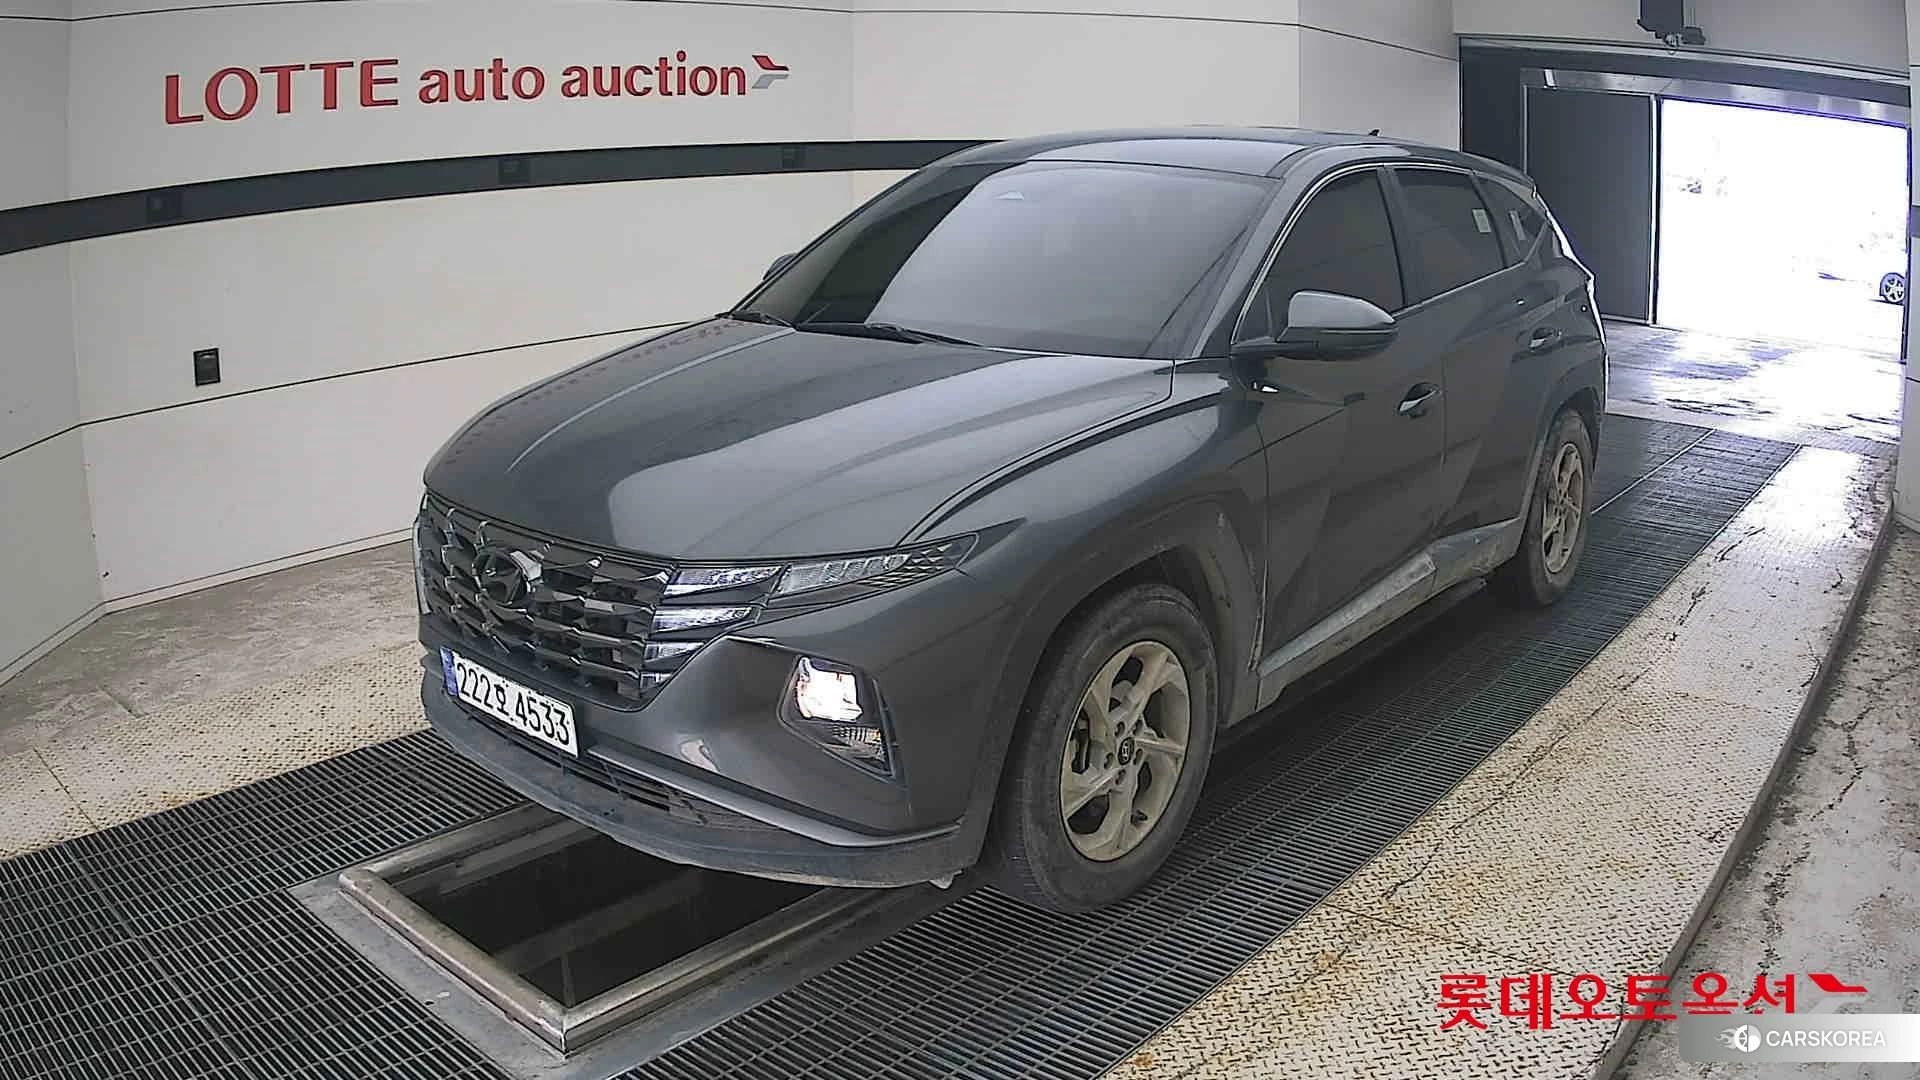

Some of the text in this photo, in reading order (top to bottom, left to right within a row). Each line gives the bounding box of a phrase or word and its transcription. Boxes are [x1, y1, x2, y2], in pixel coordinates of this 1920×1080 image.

[164, 50, 748, 126] LOTTE auto auction
[515, 692, 570, 746] 4533
